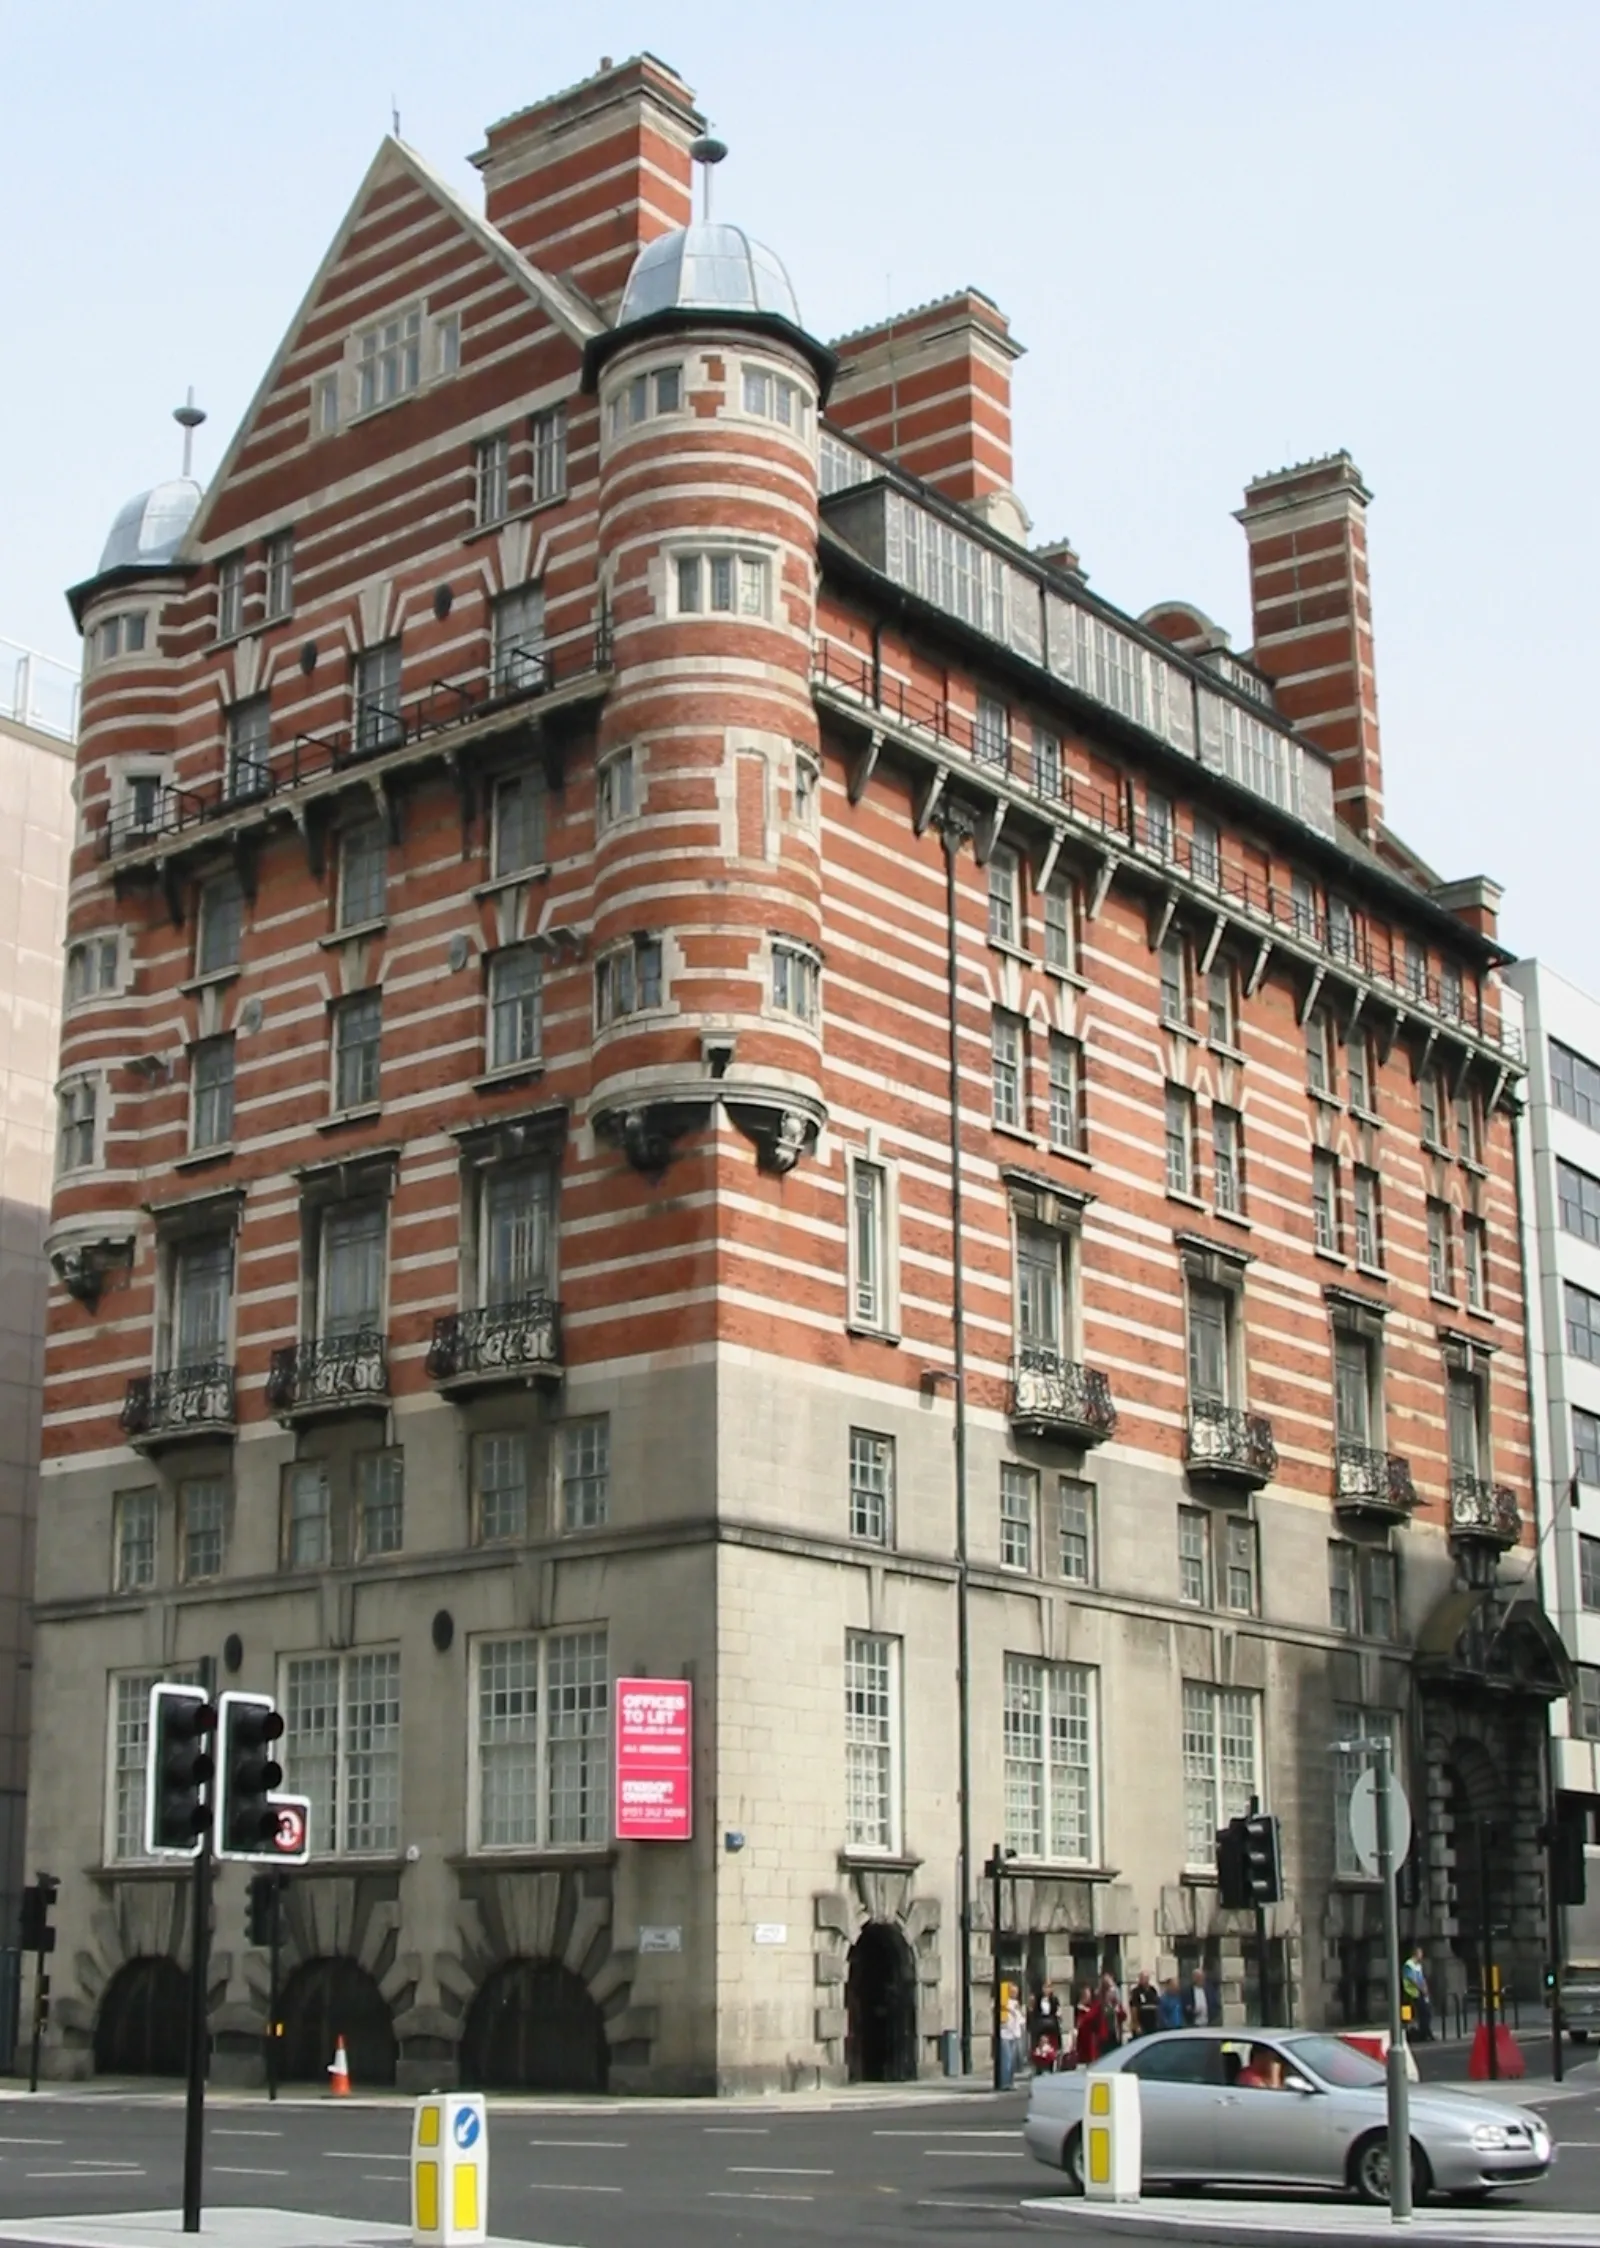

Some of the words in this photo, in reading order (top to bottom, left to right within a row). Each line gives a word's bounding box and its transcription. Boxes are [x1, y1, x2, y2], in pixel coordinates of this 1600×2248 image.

[623, 1694, 686, 1709] OFFICES
[623, 1709, 644, 1724] TO
[647, 1710, 676, 1725] LET
